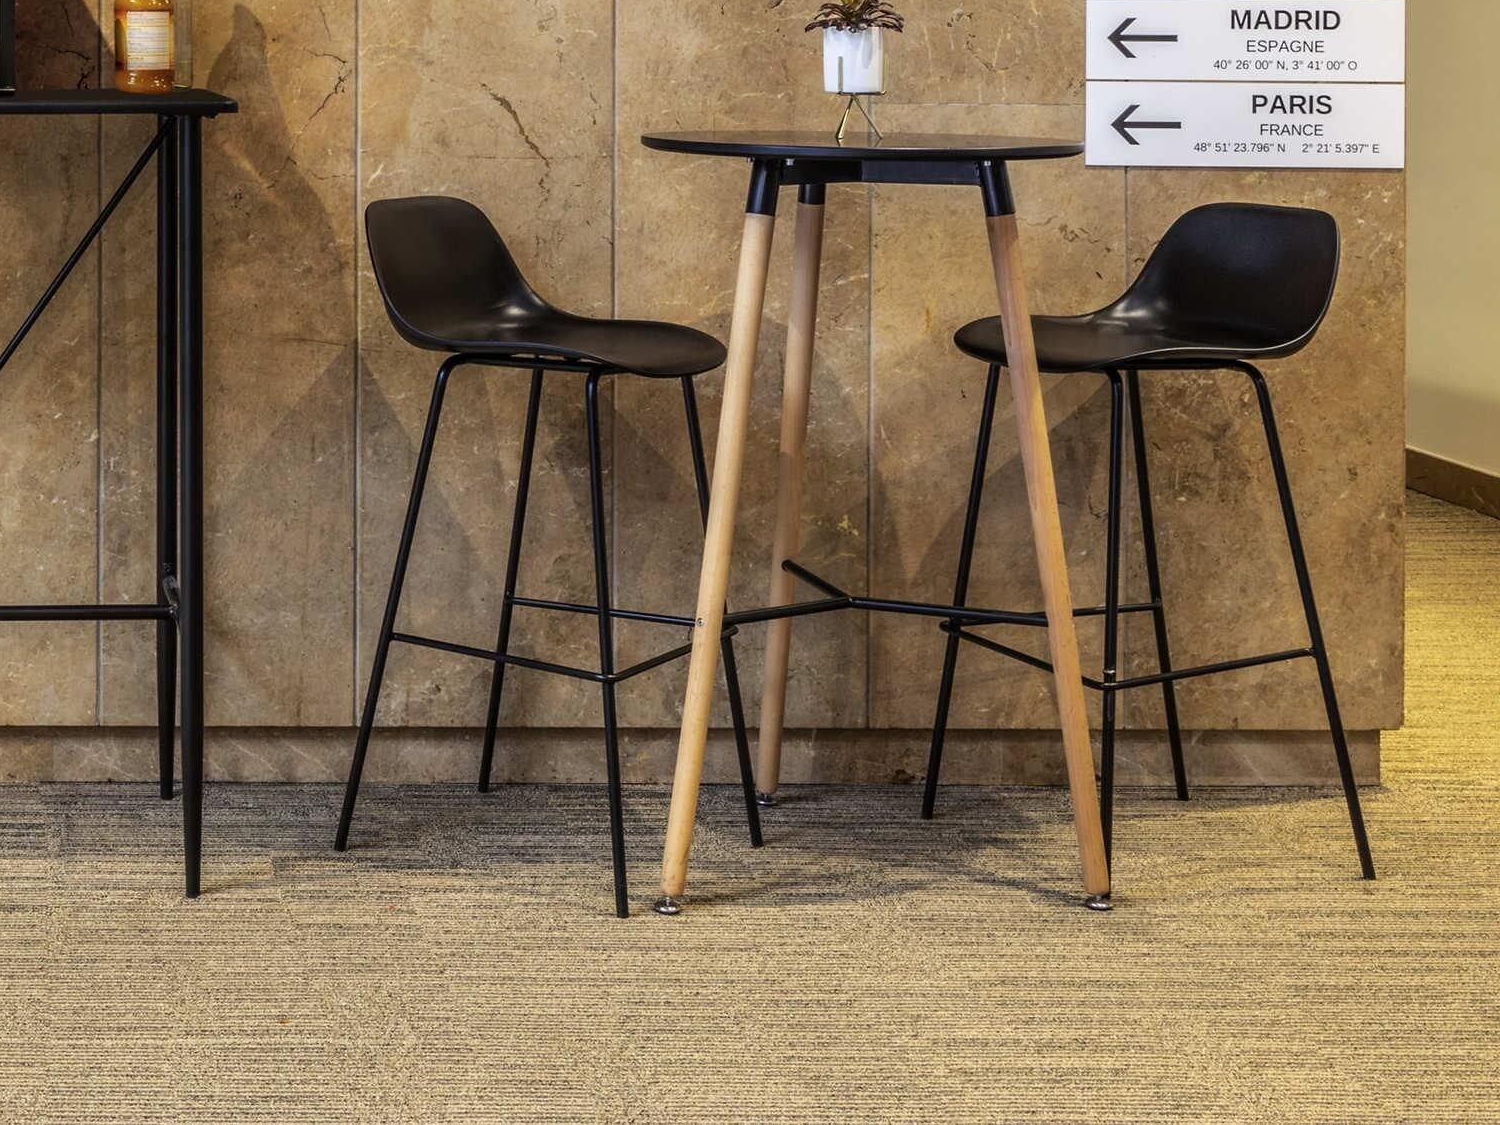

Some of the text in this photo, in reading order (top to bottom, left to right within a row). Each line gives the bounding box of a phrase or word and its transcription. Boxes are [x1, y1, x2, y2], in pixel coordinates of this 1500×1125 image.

[1230, 8, 1342, 31] MADRID
[1246, 39, 1325, 54] ESPAGNE
[1347, 60, 1358, 71] O
[1251, 93, 1333, 116] PARIS
[1259, 122, 1324, 137] FRANCE
[1276, 142, 1286, 154] N
[1371, 143, 1381, 154] E
